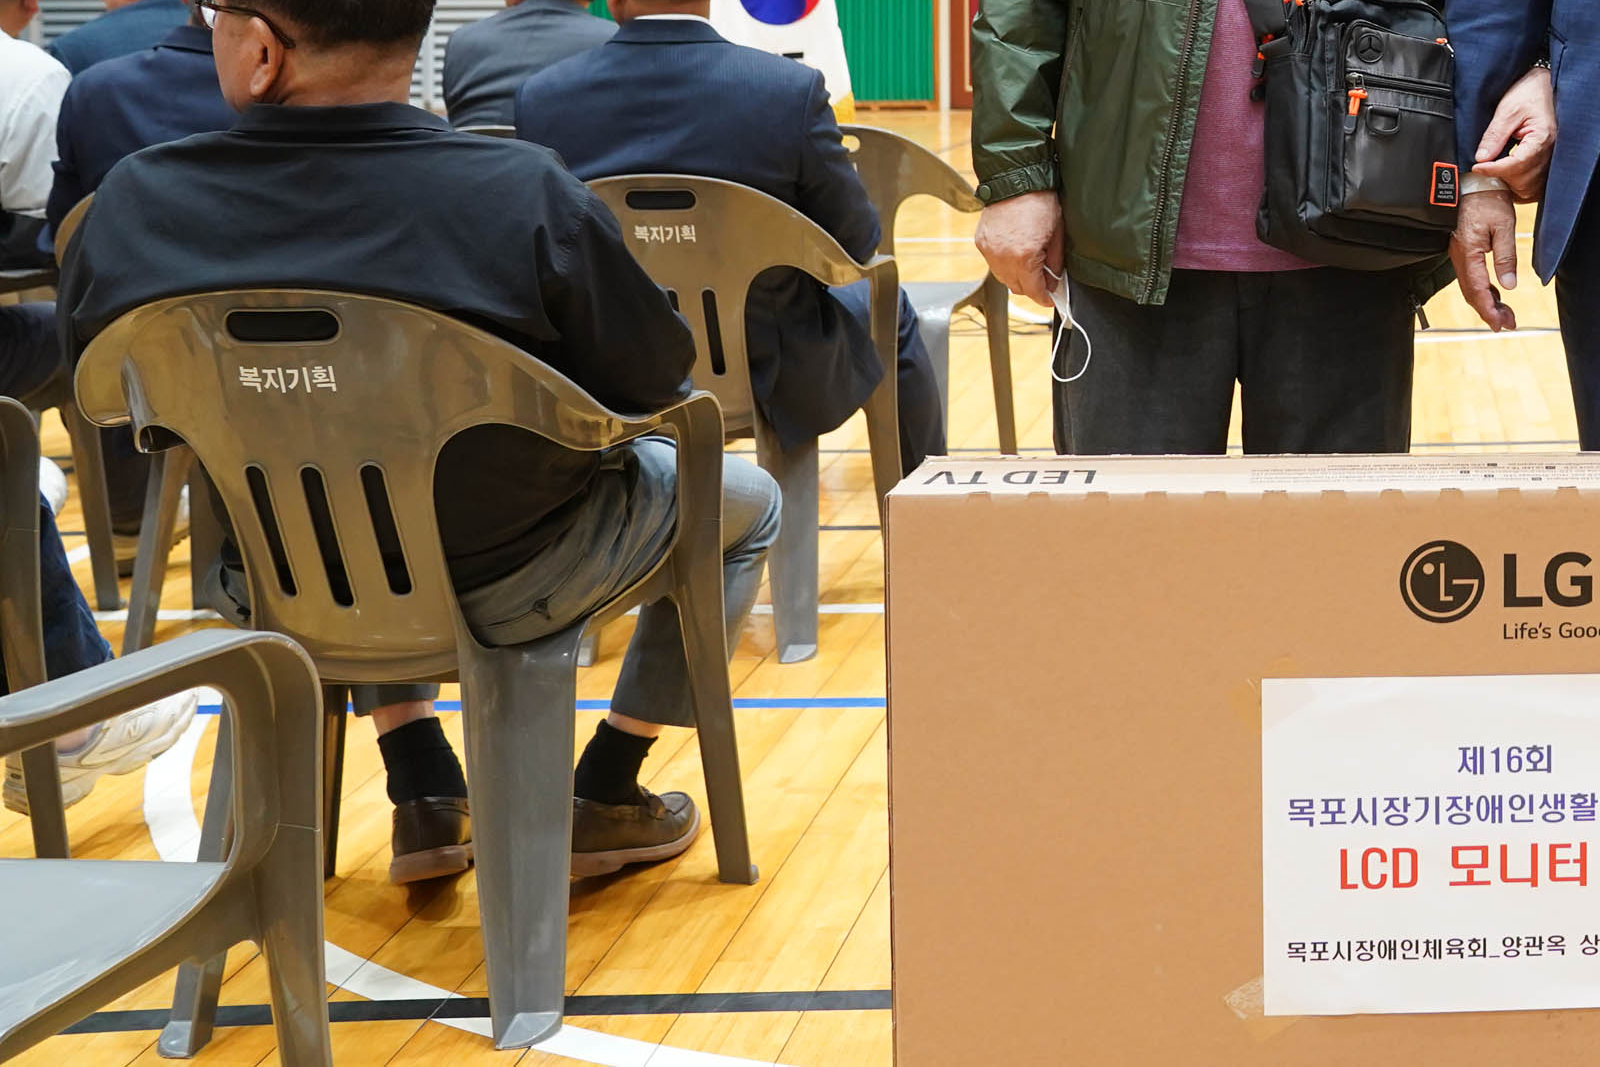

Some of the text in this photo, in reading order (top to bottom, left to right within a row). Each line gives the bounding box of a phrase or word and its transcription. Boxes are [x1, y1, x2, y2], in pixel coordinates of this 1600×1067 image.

[633, 224, 697, 243] 복지기획
[239, 365, 337, 393] 복지기획
[923, 470, 1097, 485] LED TV
[1503, 551, 1593, 608] LG
[1503, 622, 1552, 640] Life's
[1457, 745, 1553, 776] 제16회
[1339, 847, 1419, 890] LCD
[1449, 841, 1588, 888] 모니터
